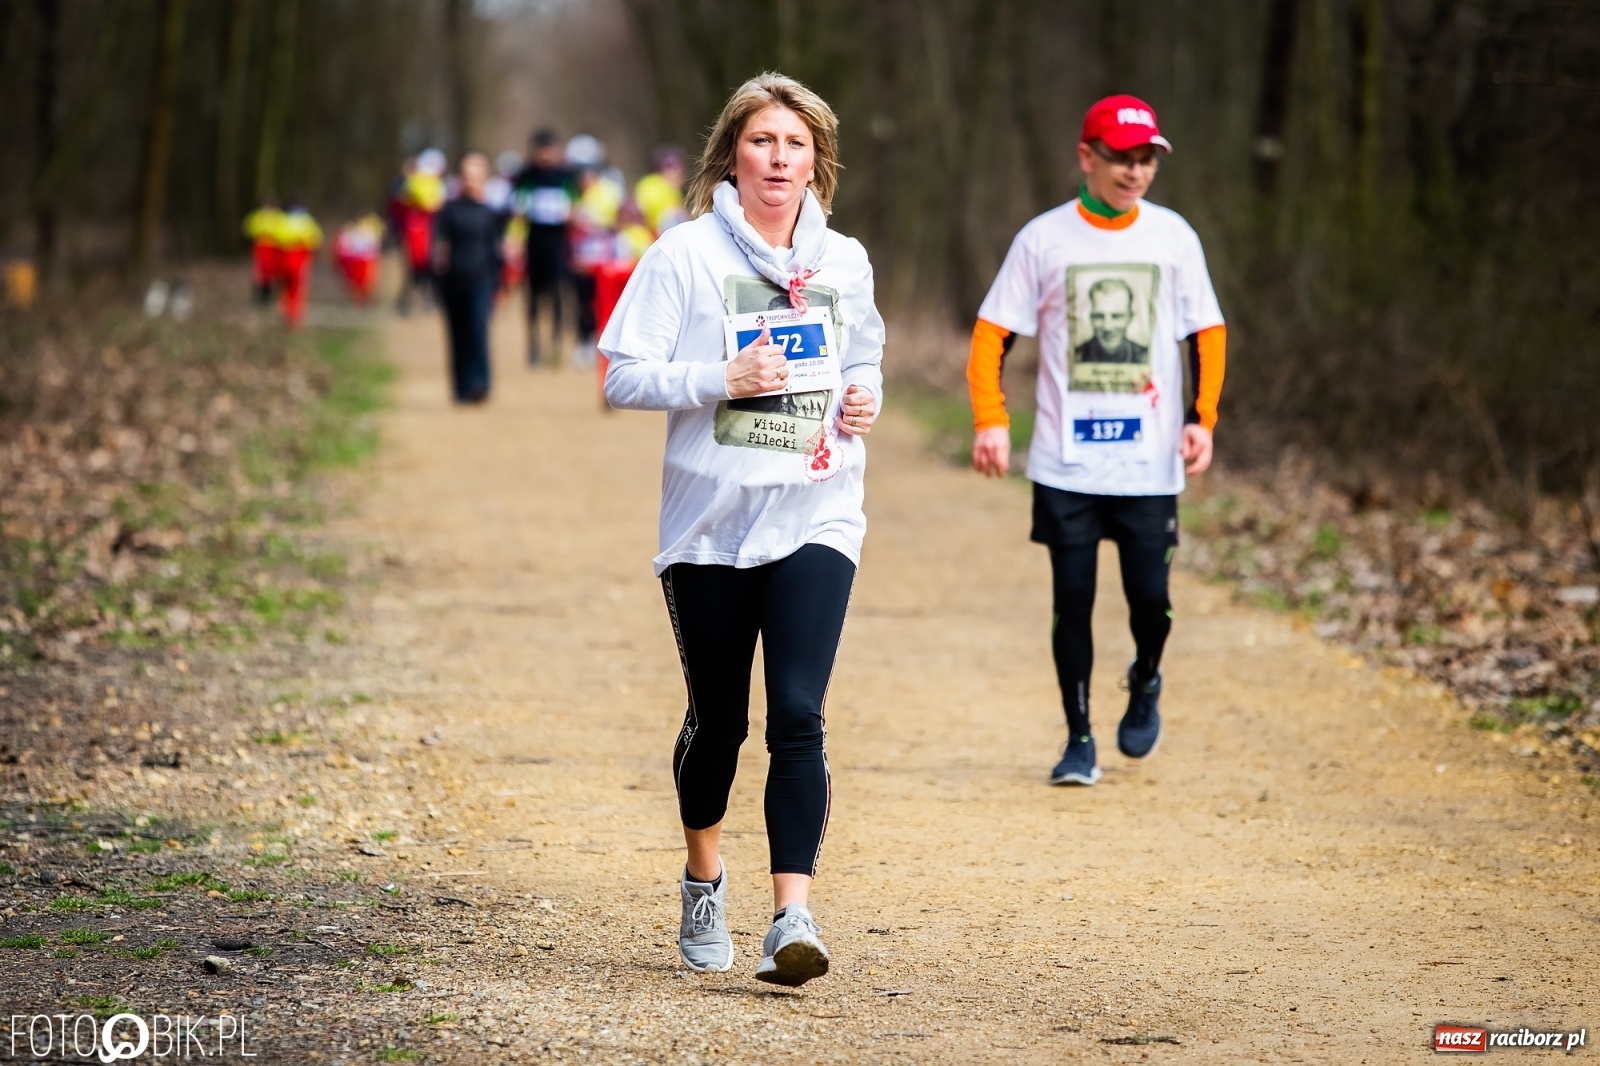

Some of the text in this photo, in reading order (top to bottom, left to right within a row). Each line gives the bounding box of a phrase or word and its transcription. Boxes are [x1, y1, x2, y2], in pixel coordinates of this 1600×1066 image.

[753, 418, 797, 435] Witold
[1092, 421, 1125, 440] 137
[747, 432, 798, 450] Pilecki
